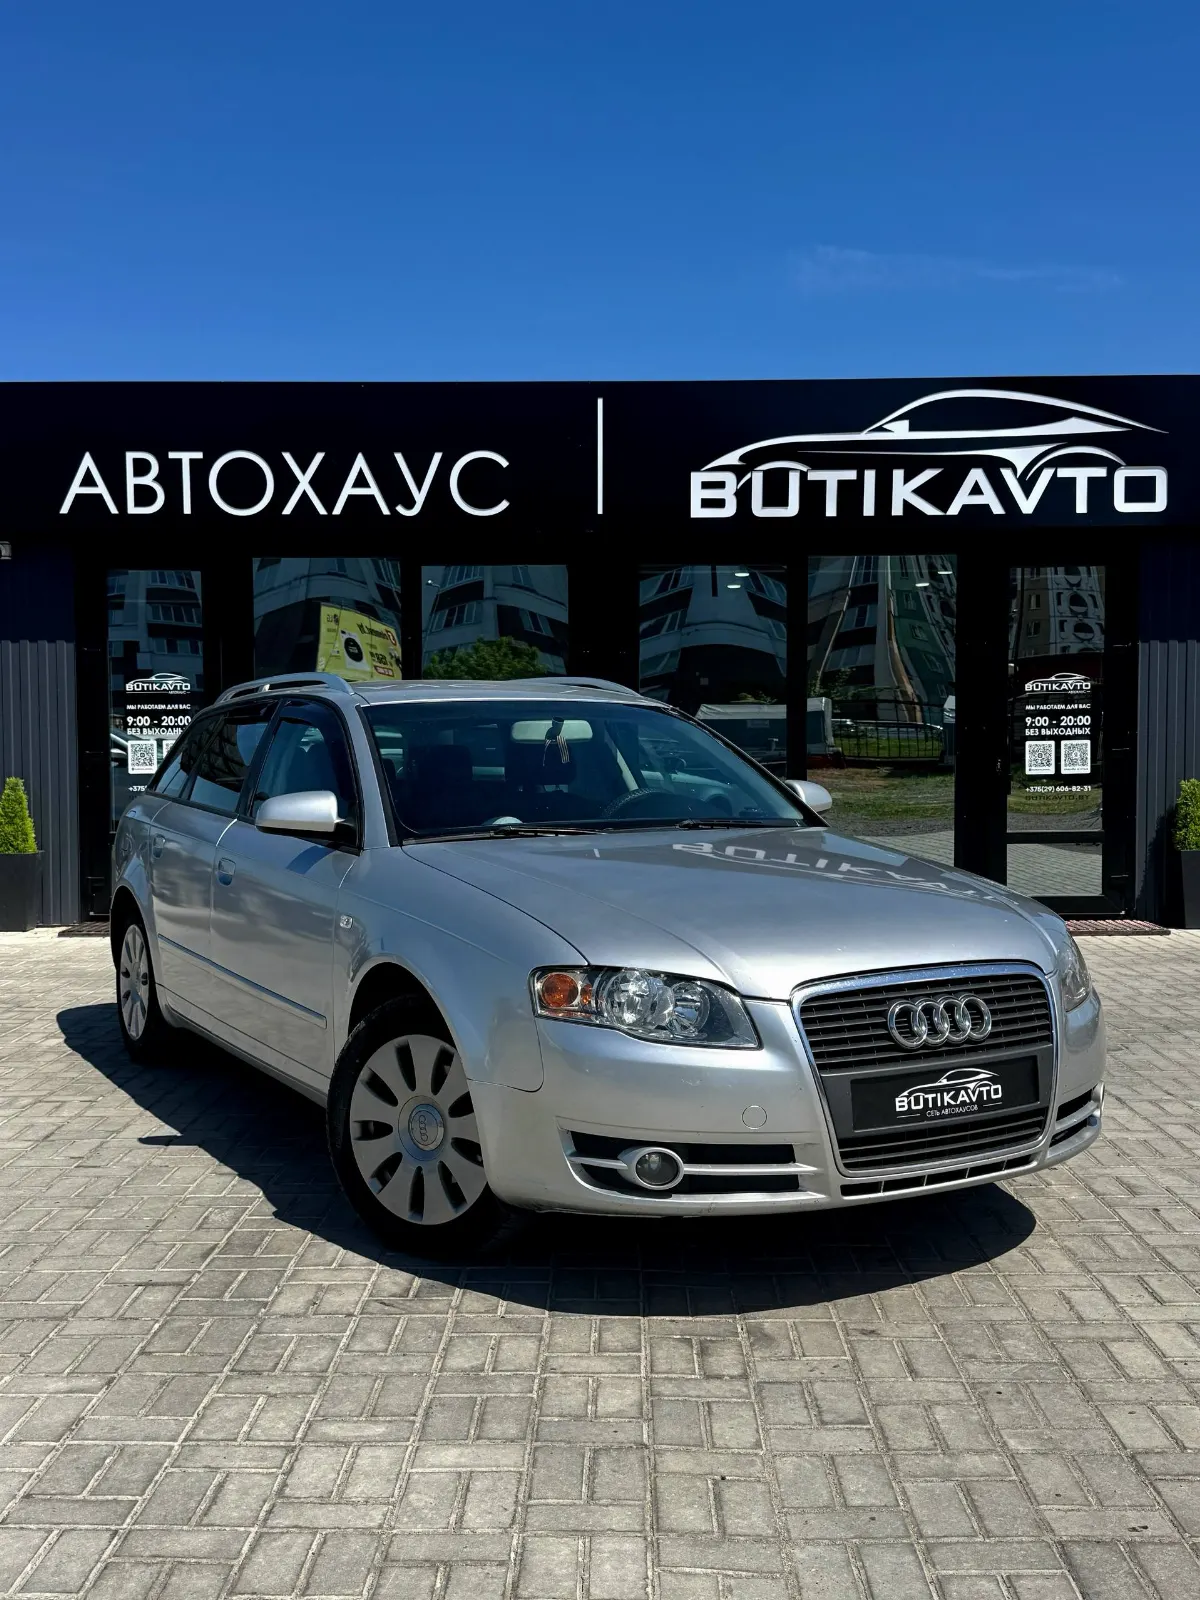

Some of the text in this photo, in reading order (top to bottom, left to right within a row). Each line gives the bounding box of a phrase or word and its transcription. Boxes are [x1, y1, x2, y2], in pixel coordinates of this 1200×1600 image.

[60, 451, 509, 517] АВТОХАУС
[691, 467, 1168, 518] BUTIKAVTO
[126, 683, 191, 691] BUTIKAVTO
[1025, 682, 1091, 691] BUTIKAVTO
[126, 716, 151, 726] 9:00
[161, 716, 191, 726] 20:00
[1025, 716, 1049, 727] 9:00
[1060, 715, 1091, 726] 20:00
[1025, 727, 1091, 736] БЕЗ ВЫХОДНЫХ
[895, 1084, 1003, 1112] BUTIKAVTO
[941, 1104, 979, 1116] АВТОХАУСОВ
